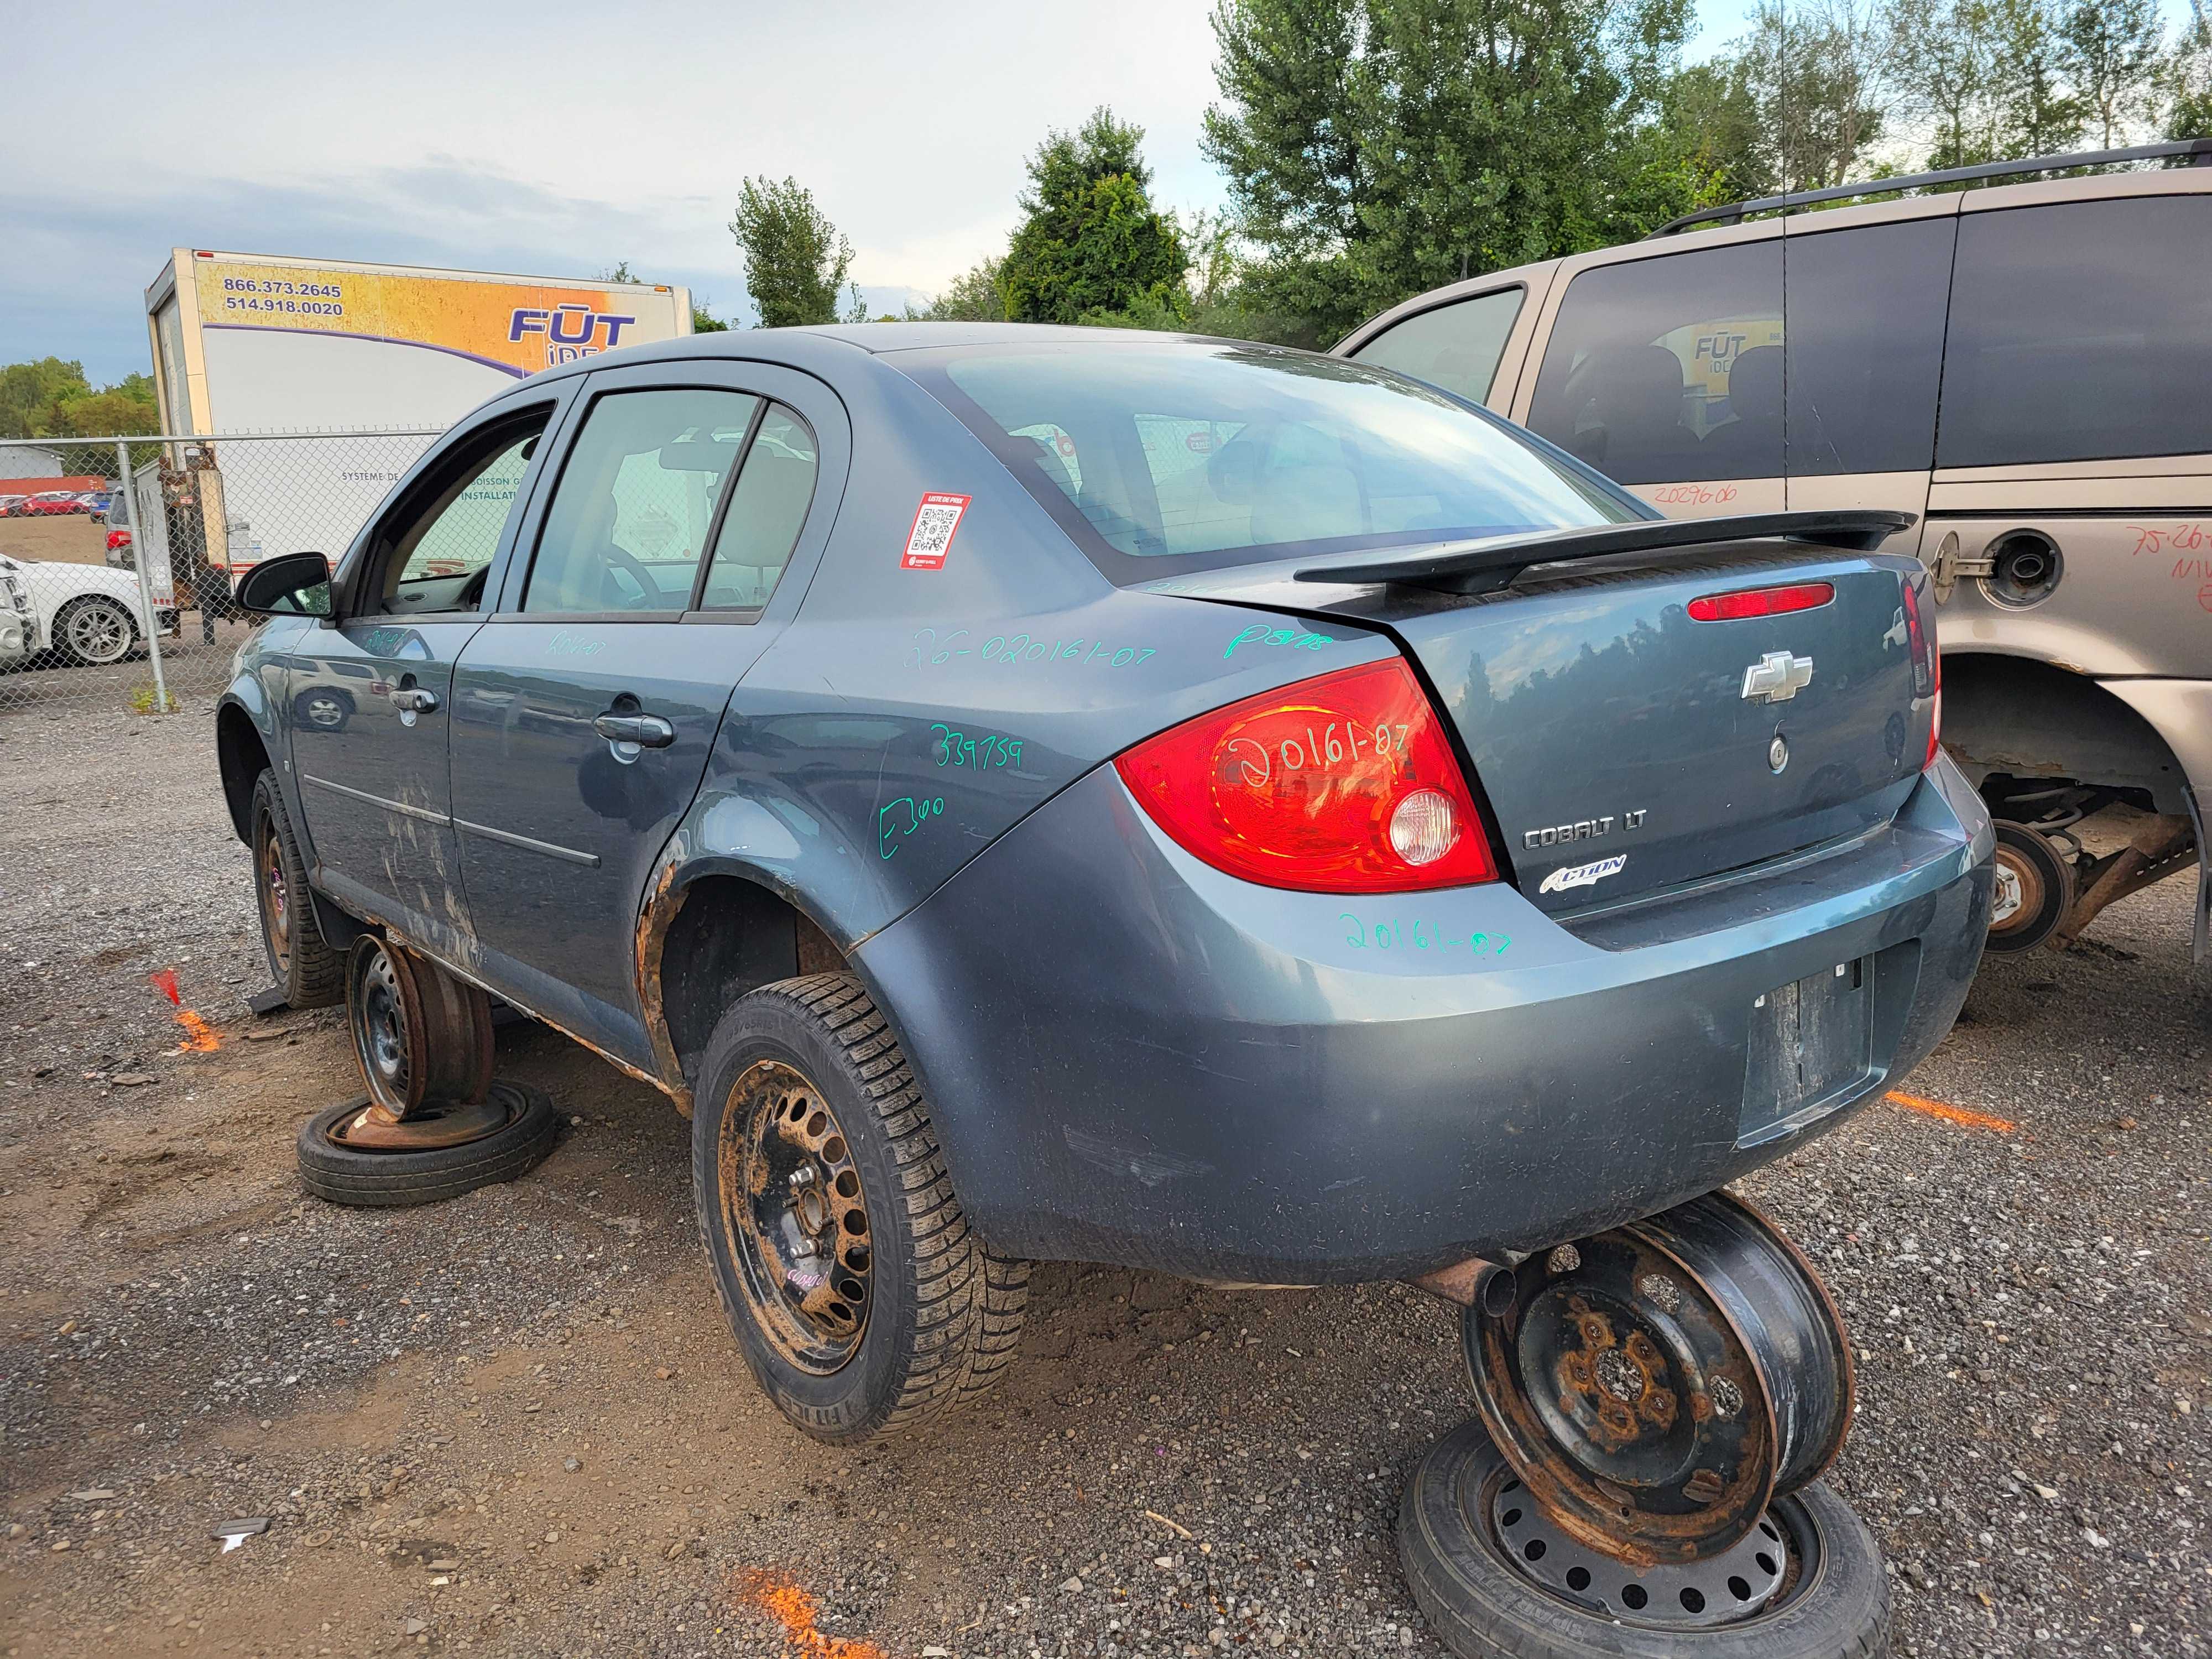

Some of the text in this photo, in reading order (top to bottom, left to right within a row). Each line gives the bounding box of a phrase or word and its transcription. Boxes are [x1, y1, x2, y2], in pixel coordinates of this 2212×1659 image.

[224, 278, 341, 298] 866.373.2645
[226, 297, 342, 315] 514.918.0020
[461, 491, 516, 500] INSTALLATI
[1228, 722, 1408, 787] 20161-07
[1522, 809, 1647, 851] COBALT LT
